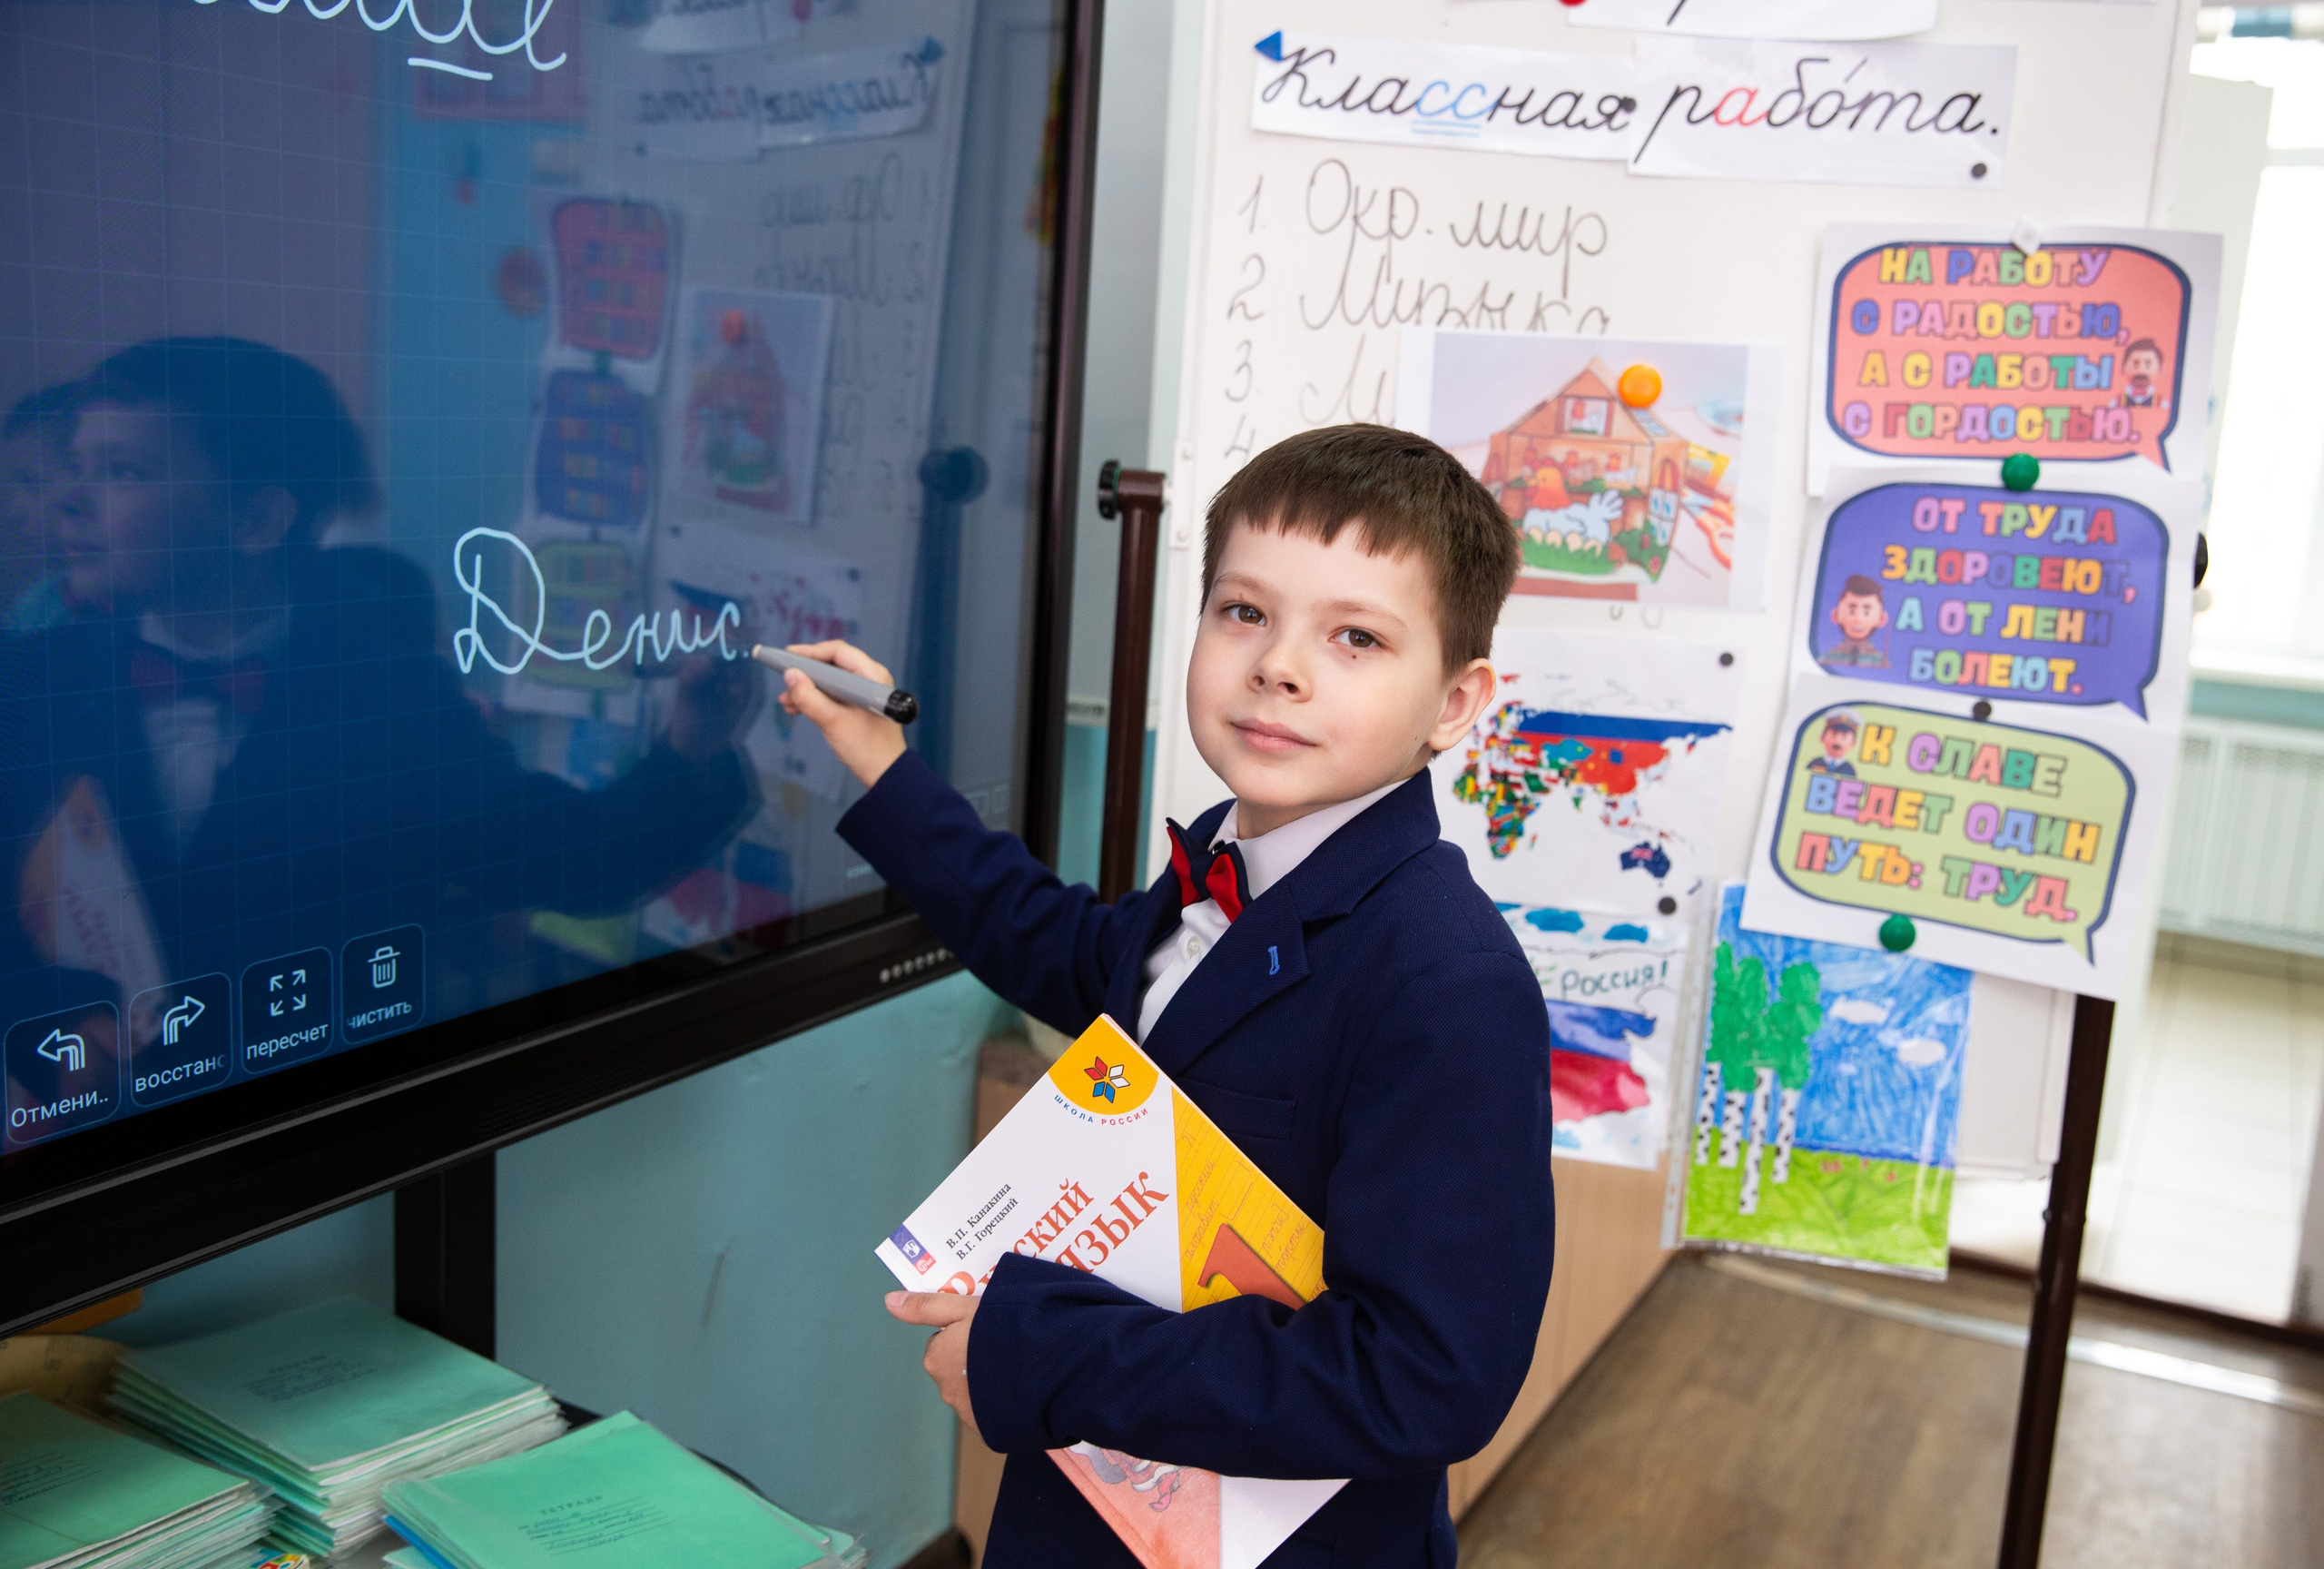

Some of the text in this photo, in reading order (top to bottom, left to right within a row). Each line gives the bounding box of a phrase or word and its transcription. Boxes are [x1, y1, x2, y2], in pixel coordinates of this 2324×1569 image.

[1263, 47, 1630, 130] Классная
[1450, 201, 1607, 300] мир
[1879, 248, 2111, 287] НА РАБОТУ
[1851, 299, 2130, 346] С РАДОСТЬЮ,
[1858, 350, 2114, 390] А С РАБОТЫ
[1843, 400, 2140, 444] С ГОРДОСТЬЮ.
[1912, 497, 2117, 545] ОТ ТРУДА
[1882, 544, 2137, 605] ЗДОРОВЕЮТ,
[454, 527, 752, 675] Денис.
[1896, 597, 2112, 647] А ОТ ЛЕНИ
[1909, 648, 2083, 696] БОЛЕЮТ.
[1859, 723, 2068, 797] К СЛАВЕ
[1805, 775, 2101, 863] ВЕДЕТ ОДИН
[1795, 831, 2079, 923] ПУТЬ: ТРУД.
[246, 1022, 329, 1061] пересчет
[11, 1091, 109, 1129] Отмени..
[1054, 1094, 1148, 1125] ШКОЛА РОССИИ
[967, 1183, 1011, 1229] Канакина
[974, 1197, 1019, 1241] Горецкий
[938, 1178, 1094, 1296] Рский
